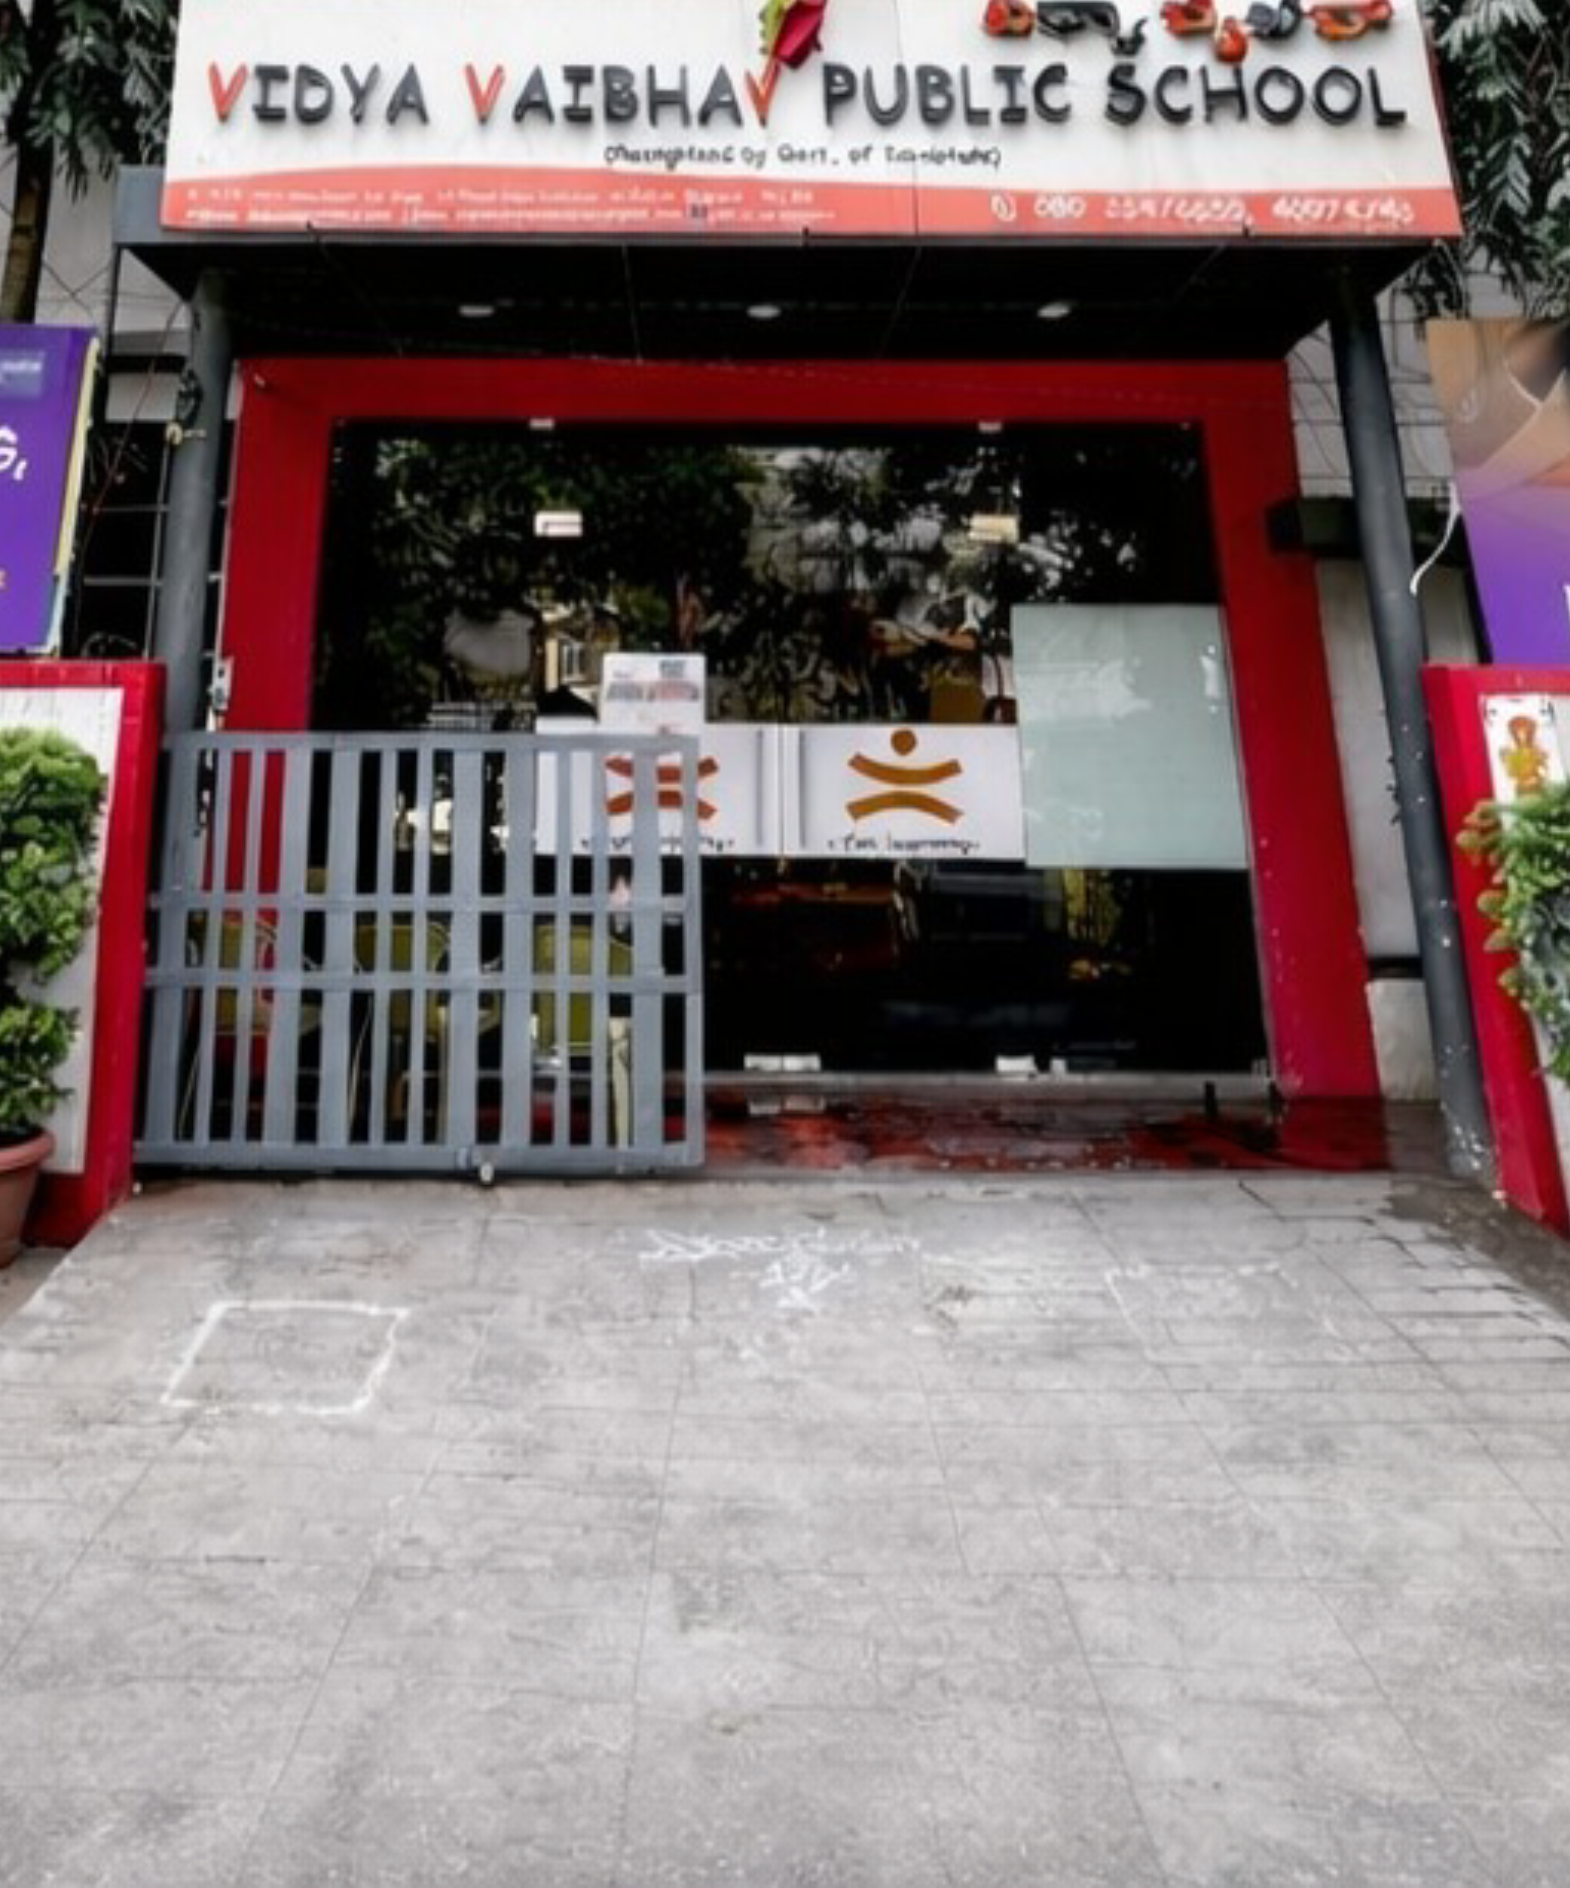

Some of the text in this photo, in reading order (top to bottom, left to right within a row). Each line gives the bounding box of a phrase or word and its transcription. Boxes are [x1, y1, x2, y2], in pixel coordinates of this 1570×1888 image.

[208, 62, 1408, 128] VIDYA VAIBHAV PUBLIC SCHOOL
